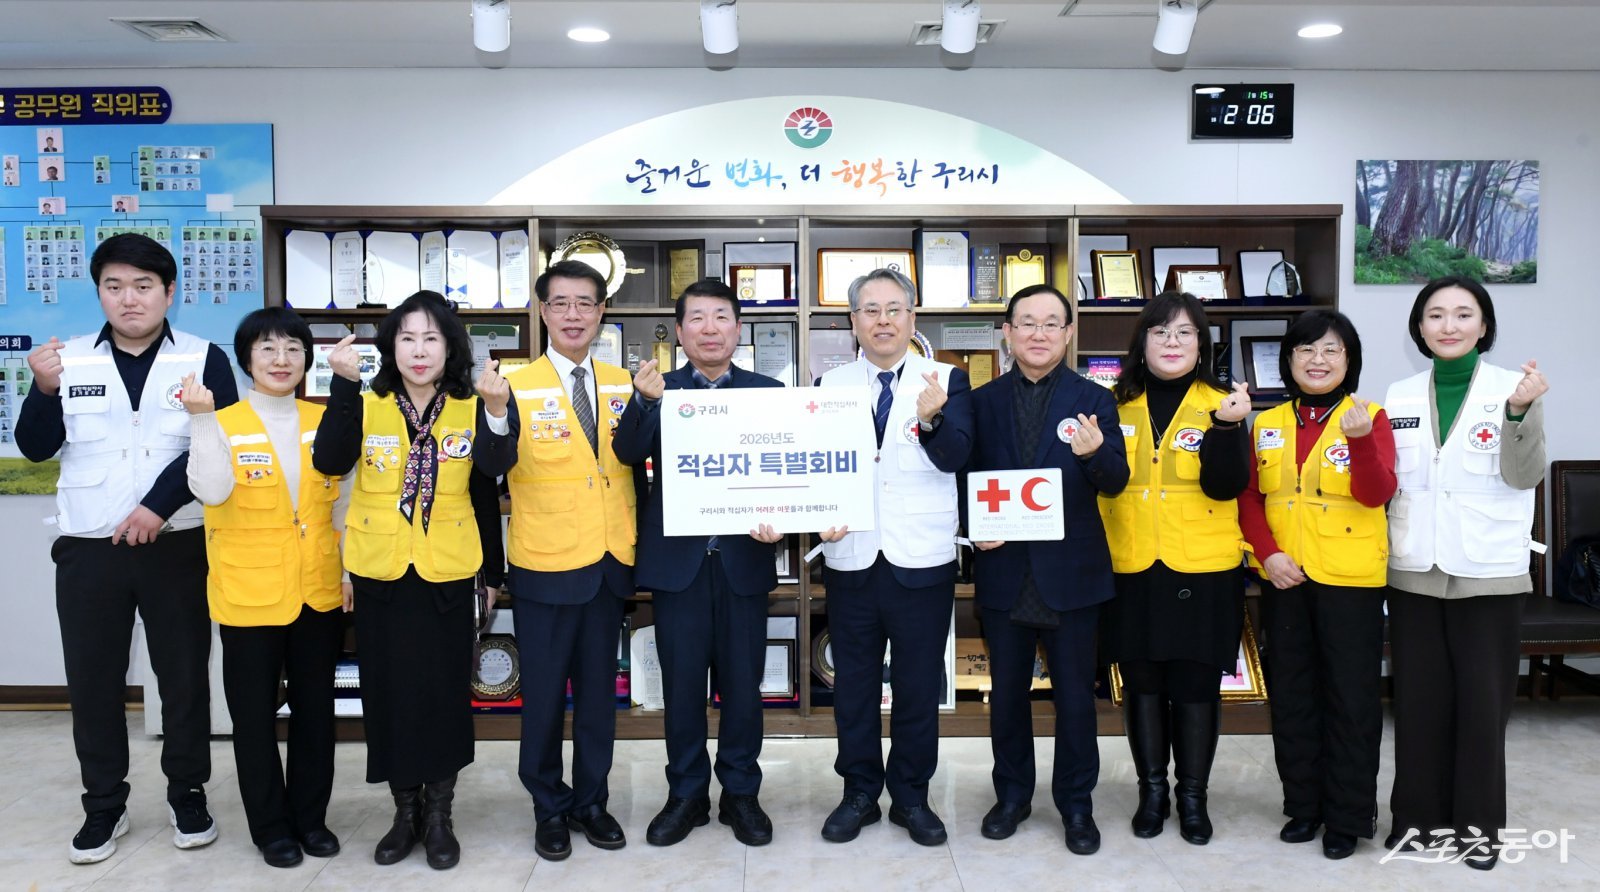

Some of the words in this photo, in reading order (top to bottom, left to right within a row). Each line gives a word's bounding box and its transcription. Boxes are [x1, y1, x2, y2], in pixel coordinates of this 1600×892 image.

[14, 93, 82, 118] 공무원
[92, 92, 163, 117] 직위표
[625, 158, 711, 194] 즐거운
[800, 163, 821, 183] 더
[831, 158, 923, 197] 행복한
[932, 162, 999, 189] 구리시
[698, 404, 728, 416] 구리시
[739, 432, 795, 445] 2026년도
[677, 452, 752, 478] 적십자
[759, 450, 857, 476] 특별회비
[699, 506, 726, 516] 구리시와
[727, 506, 754, 514] 적십자가
[755, 505, 775, 514] 어려운
[777, 504, 804, 513] 이웃들과
[805, 503, 838, 513] 함께합니다
